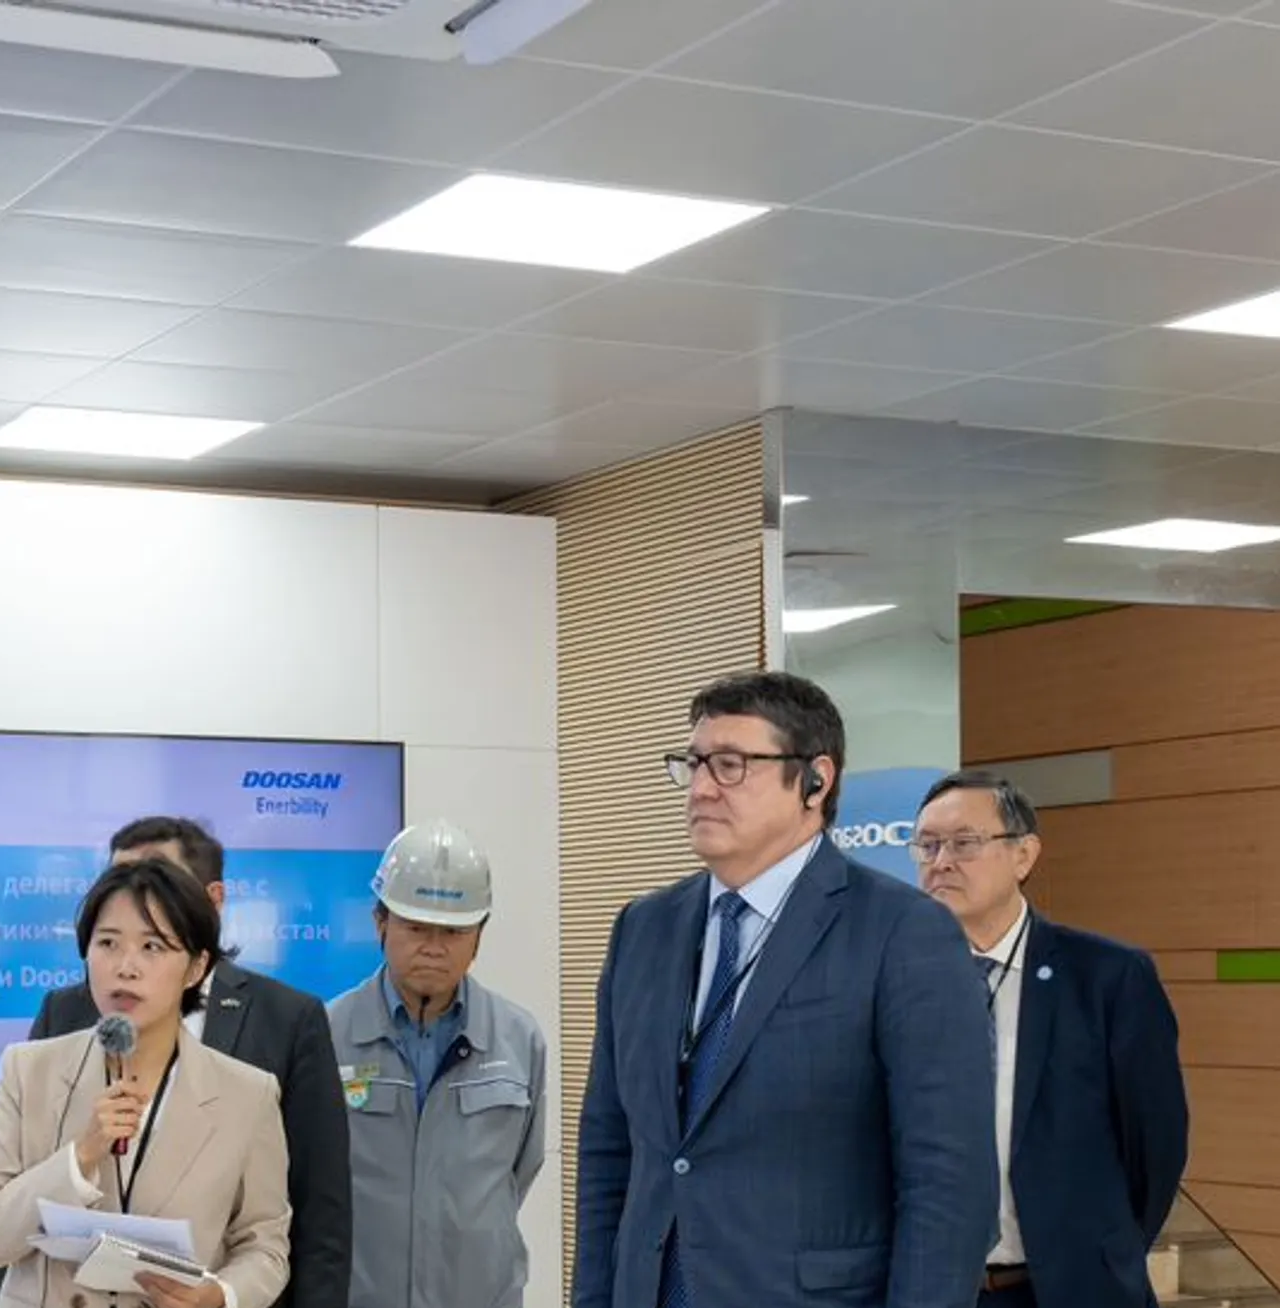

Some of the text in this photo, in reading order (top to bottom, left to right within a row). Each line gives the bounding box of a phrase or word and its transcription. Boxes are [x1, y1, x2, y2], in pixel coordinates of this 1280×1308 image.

[241, 771, 342, 789] DOOSAN
[255, 796, 329, 819] Enerbility
[3, 874, 91, 898] делега
[20, 965, 85, 988] Doos
